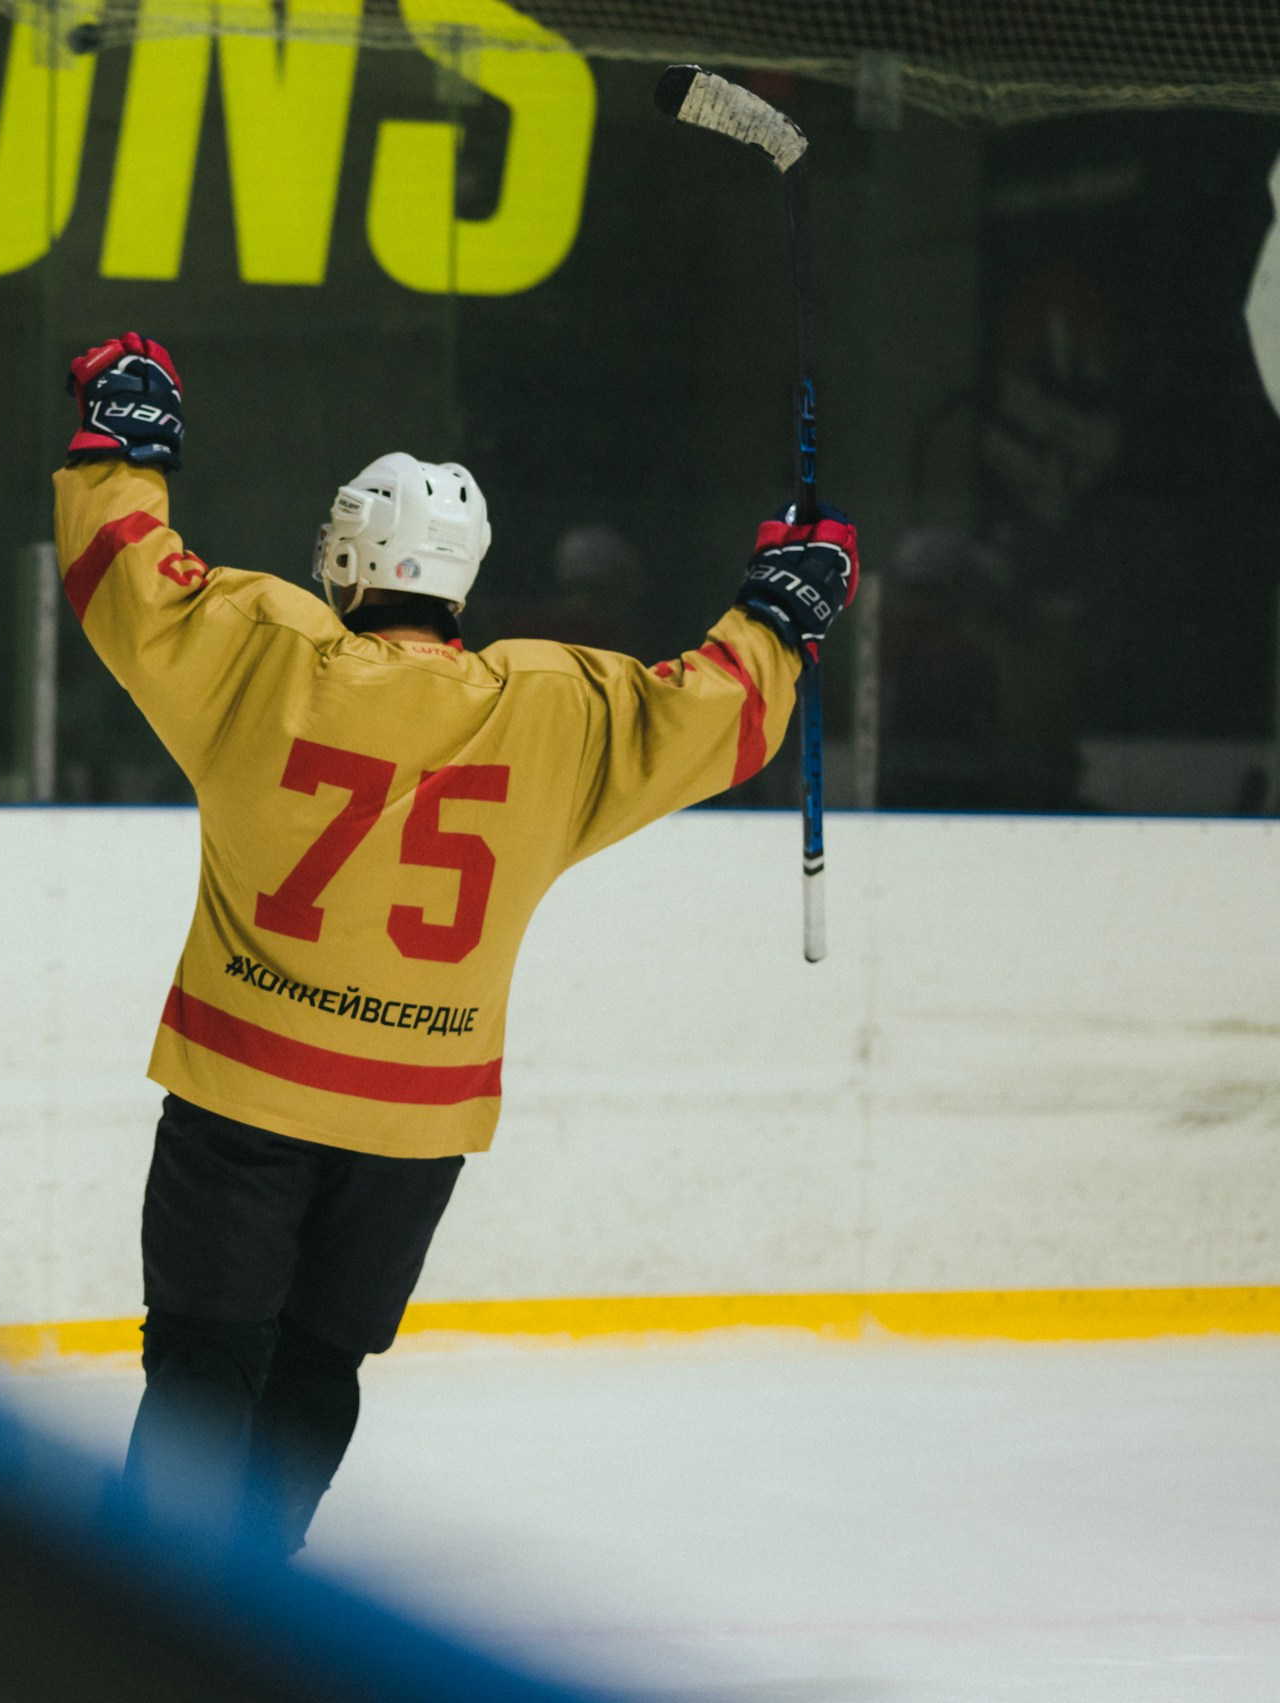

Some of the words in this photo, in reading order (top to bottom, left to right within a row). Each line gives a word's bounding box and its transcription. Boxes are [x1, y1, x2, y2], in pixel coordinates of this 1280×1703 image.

[104, 402, 183, 436] UER
[254, 737, 511, 964] 75
[224, 954, 479, 1037] #ХОККЕЙВСЕРДЦЕ
